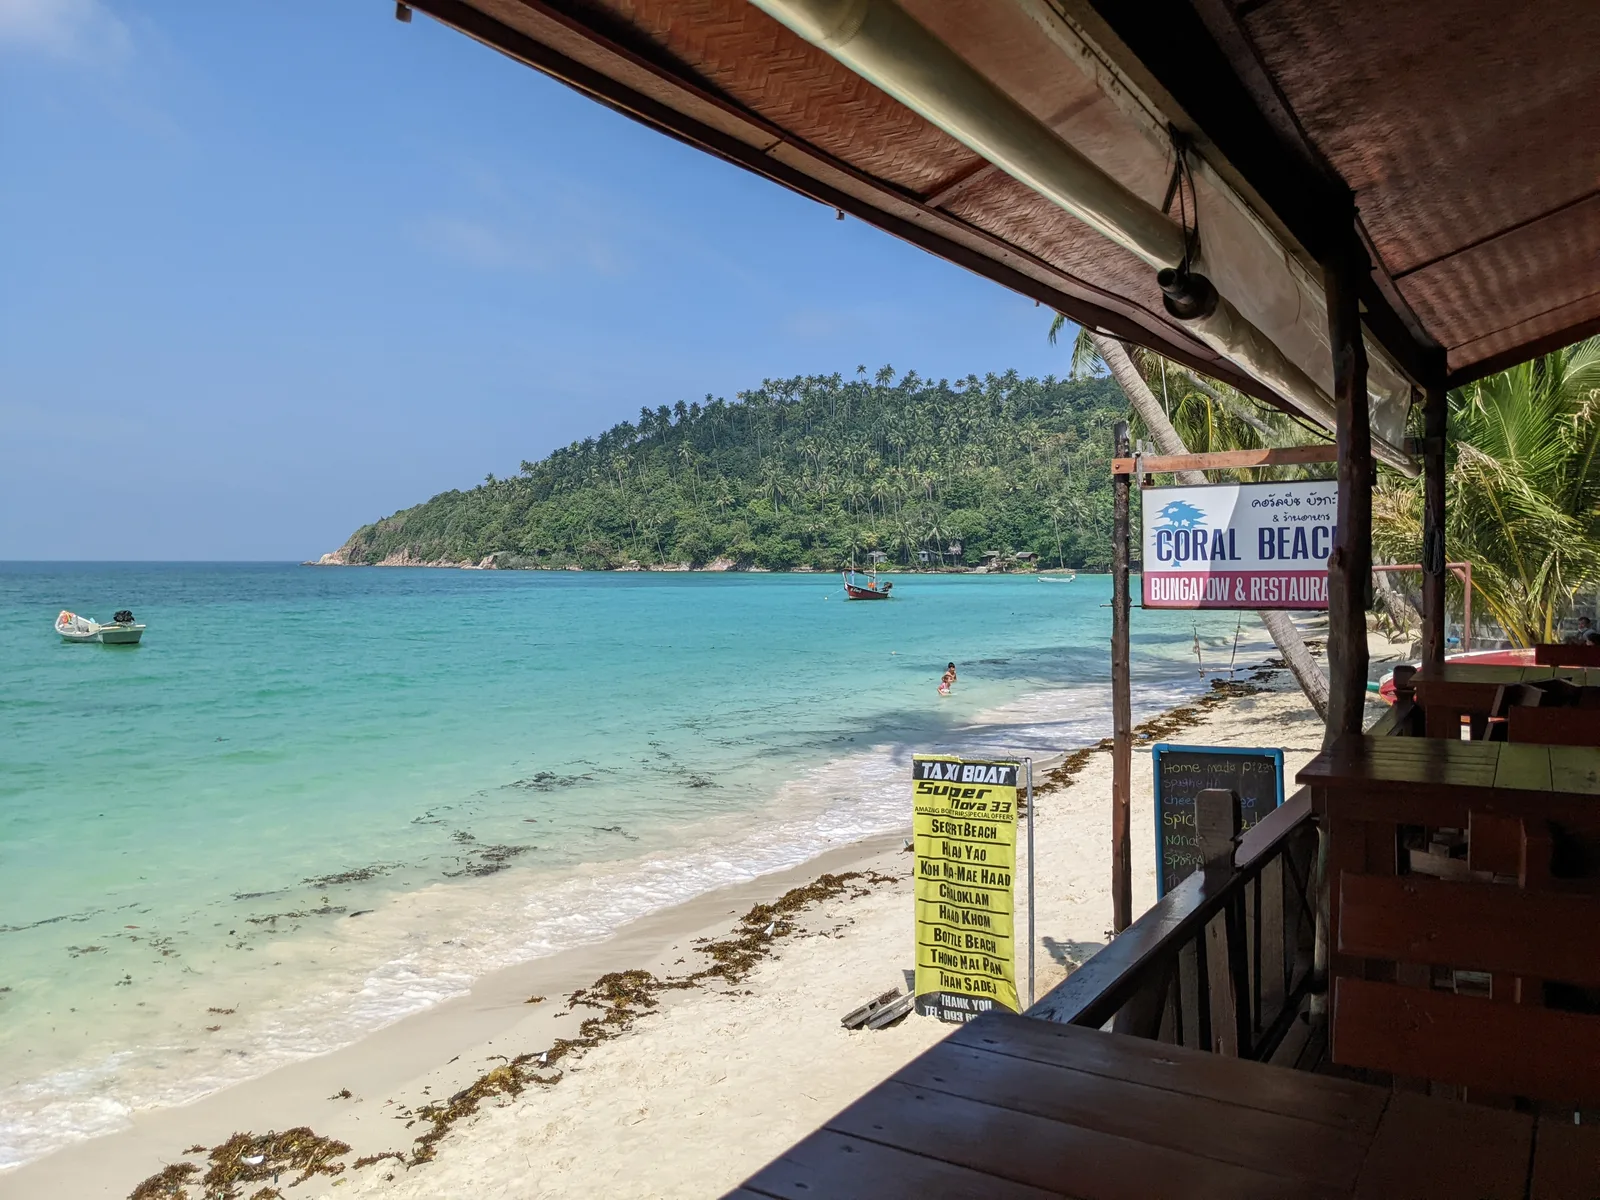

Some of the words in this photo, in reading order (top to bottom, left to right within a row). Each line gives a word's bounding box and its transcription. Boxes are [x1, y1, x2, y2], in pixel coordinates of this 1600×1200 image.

[1272, 514, 1279, 522] &
[1156, 528, 1241, 562] CORAL
[1151, 577, 1230, 601] BUNGALOW
[1234, 577, 1246, 601] &
[1250, 576, 1329, 602] RESTAURA
[921, 762, 960, 781] TAXI
[961, 765, 1010, 784] BOAT
[916, 781, 992, 800] Super
[989, 800, 1012, 813] 33
[963, 822, 997, 839] BEACH
[1163, 810, 1196, 830] Spic
[964, 844, 987, 861] YAO
[920, 860, 940, 876] KOH
[980, 868, 1011, 887] HAAD
[939, 905, 960, 924] HAAD
[961, 910, 991, 929] KHOM
[933, 928, 962, 948] BOTTLE
[965, 934, 997, 954] BEACH
[930, 948, 958, 968] THONG
[982, 957, 1003, 975] PAN
[939, 970, 962, 990] THAN
[963, 977, 998, 995] SADEJ
[941, 994, 970, 1010] THANK
